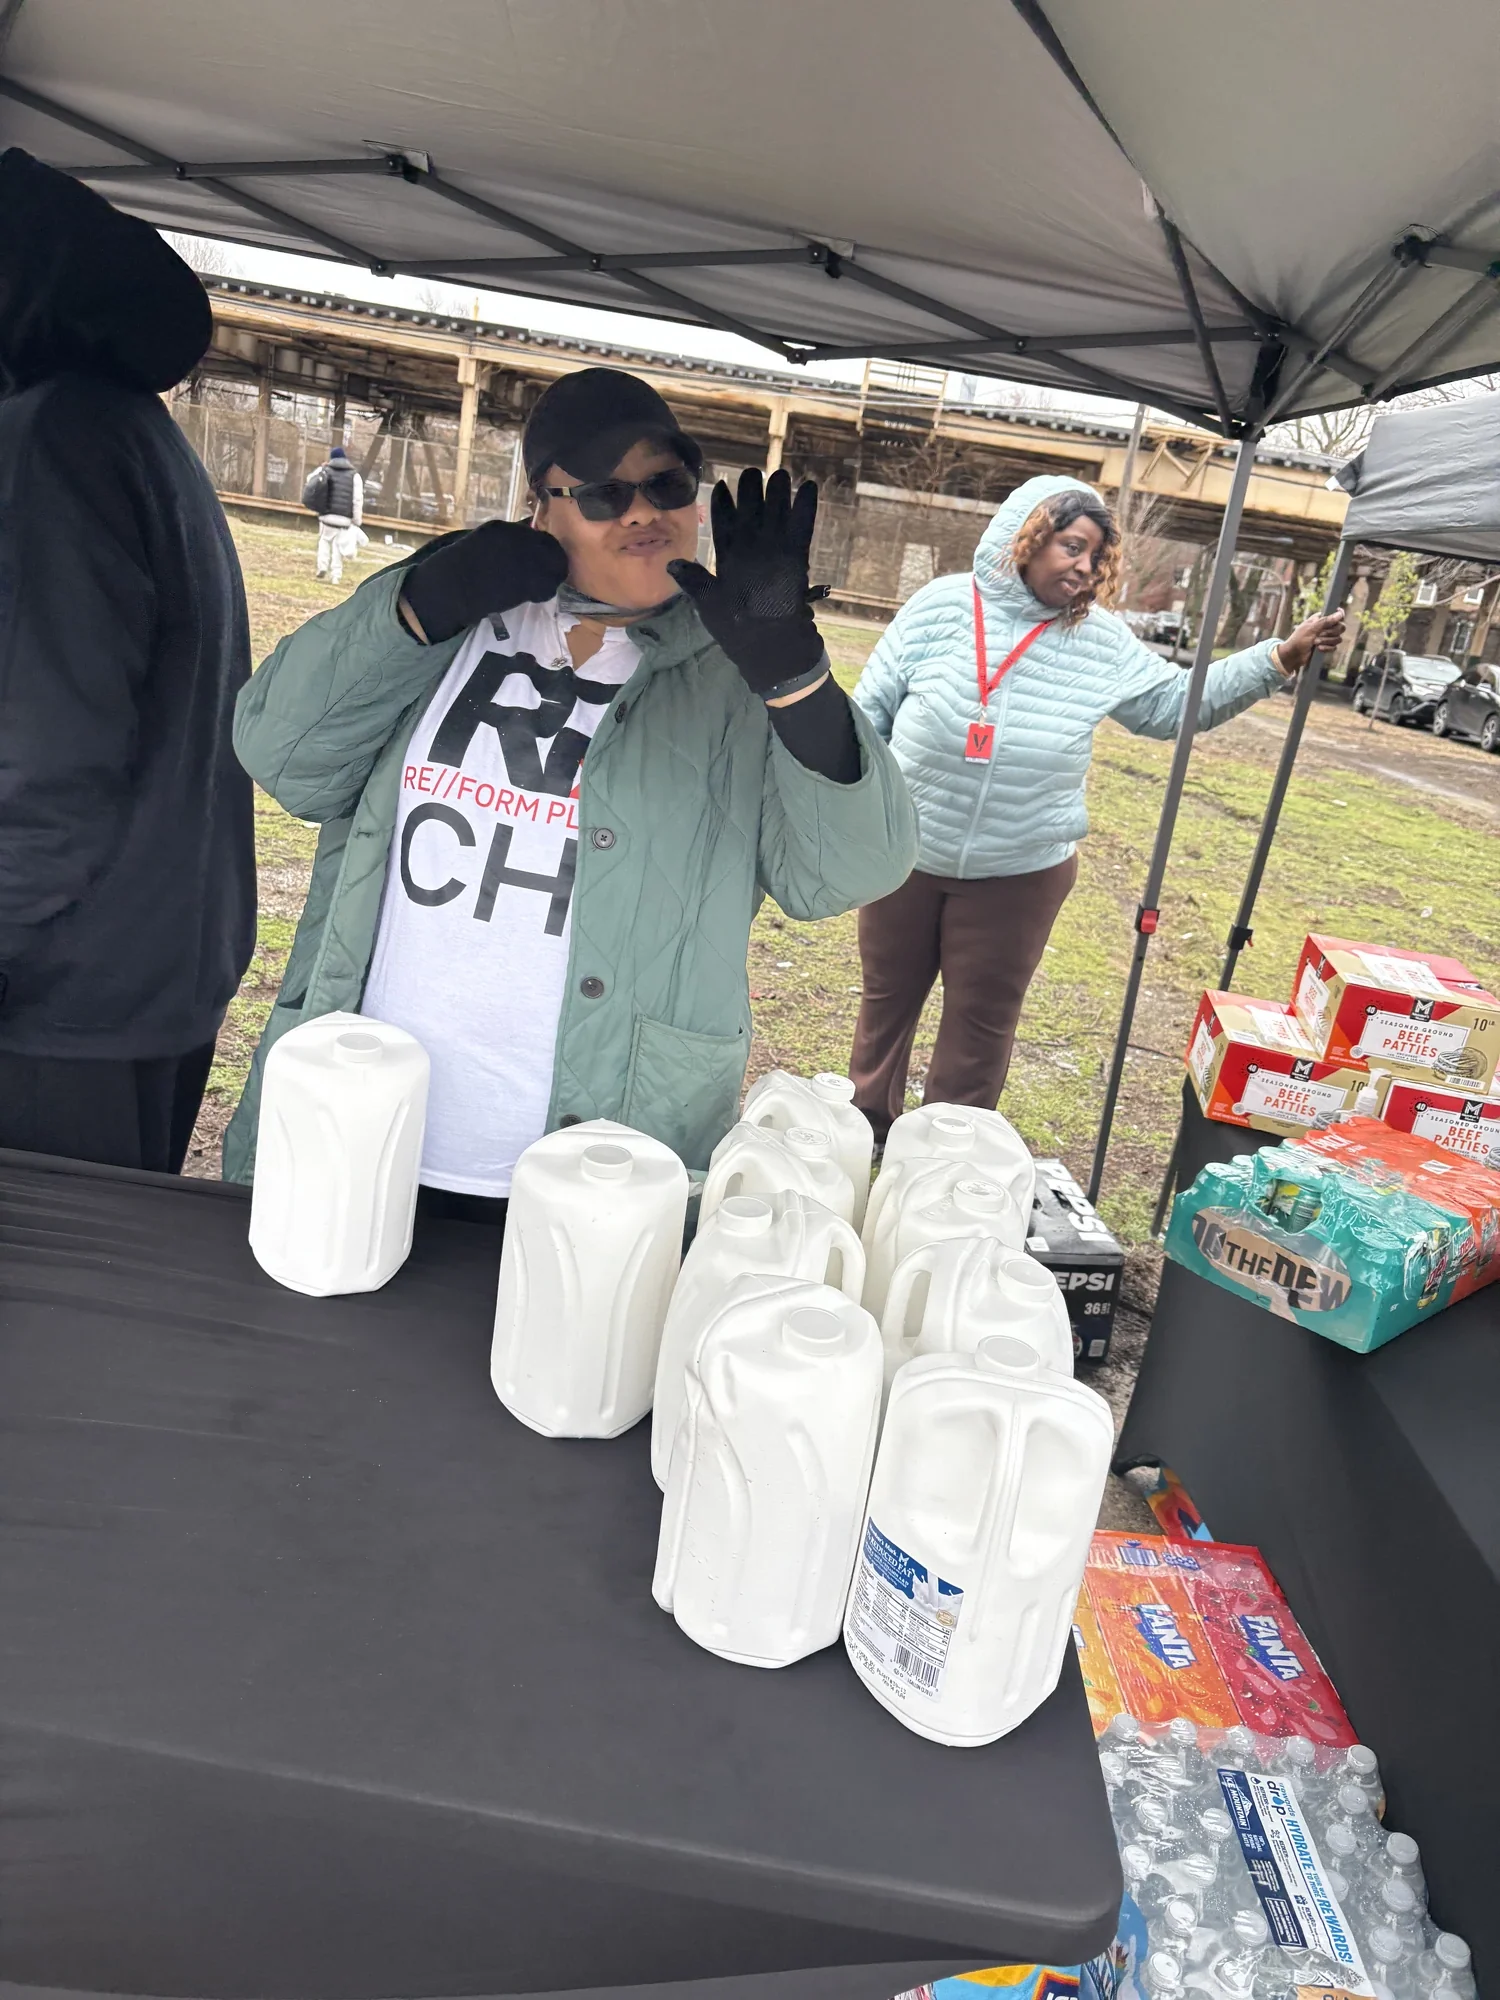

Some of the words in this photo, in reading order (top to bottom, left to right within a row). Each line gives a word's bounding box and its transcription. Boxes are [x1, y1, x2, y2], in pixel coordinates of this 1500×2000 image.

[973, 733, 989, 752] V
[403, 765, 540, 822] RE//FORM
[1380, 1019, 1419, 1034] SEASONED
[1421, 1027, 1455, 1039] GROUND
[1473, 1018, 1489, 1032] 10
[1398, 1029, 1432, 1045] BEEF
[1382, 1040, 1439, 1058] PATTIES
[1261, 1078, 1299, 1091] SEASONED
[1301, 1087, 1333, 1099] GROUND
[1277, 1087, 1311, 1103] BEEF
[1263, 1096, 1317, 1117] PATTIES
[1430, 1115, 1470, 1128] SEASONED
[1448, 1126, 1483, 1141] BEEF
[1433, 1135, 1490, 1155] PATTIES
[1035, 1162, 1116, 1243] PEPSI
[1053, 1272, 1116, 1292] EPSI
[1226, 1241, 1274, 1276] THE
[1271, 1251, 1353, 1313] DEW
[1084, 1302, 1101, 1315] 36
[870, 1536, 898, 1567] REDUCED
[897, 1563, 913, 1578] FAT
[1141, 1603, 1196, 1668] FANTA
[1245, 1614, 1304, 1680] FANTA
[1224, 1775, 1236, 1789] ICE
[1230, 1786, 1247, 1827] MOUNTAIN
[1285, 1819, 1316, 1871] HYDRATE
[1310, 1880, 1321, 1897] MORE
[1317, 1898, 1355, 1964] REWARDS!
